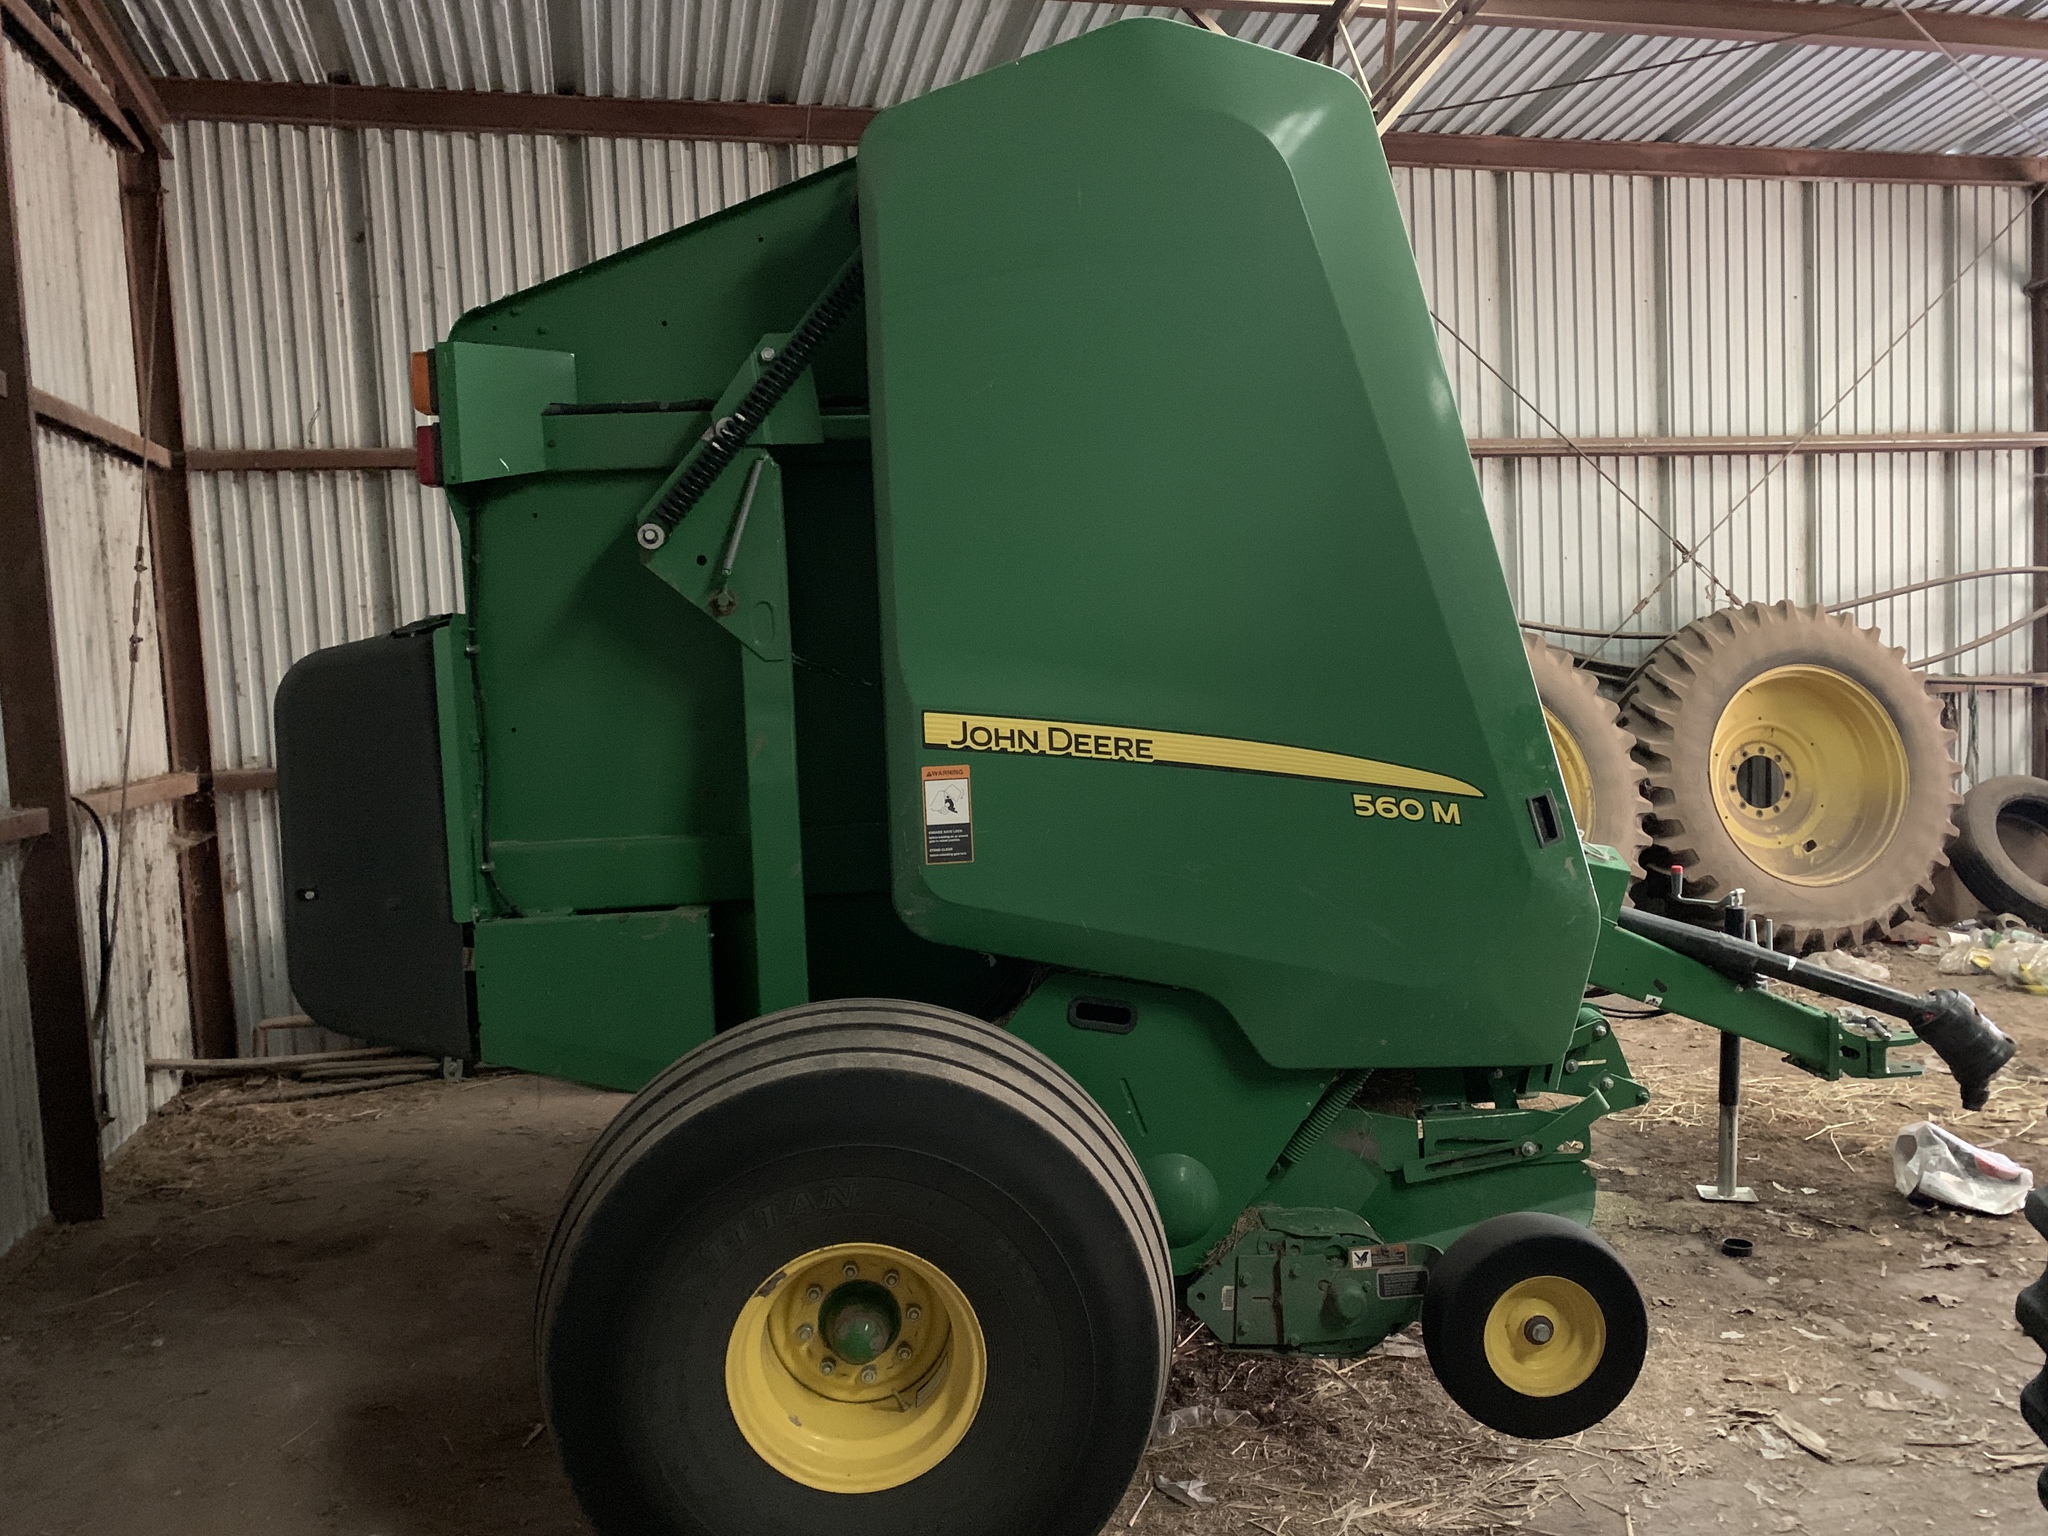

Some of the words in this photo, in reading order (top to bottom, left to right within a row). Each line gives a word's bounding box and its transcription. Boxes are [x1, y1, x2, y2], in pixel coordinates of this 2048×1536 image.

[950, 720, 1039, 750] JOHN
[1047, 726, 1154, 760] DEERE
[931, 769, 963, 777] WARNING
[1352, 793, 1425, 821] 560
[1431, 800, 1461, 825] M
[698, 1181, 857, 1264] TITAN
